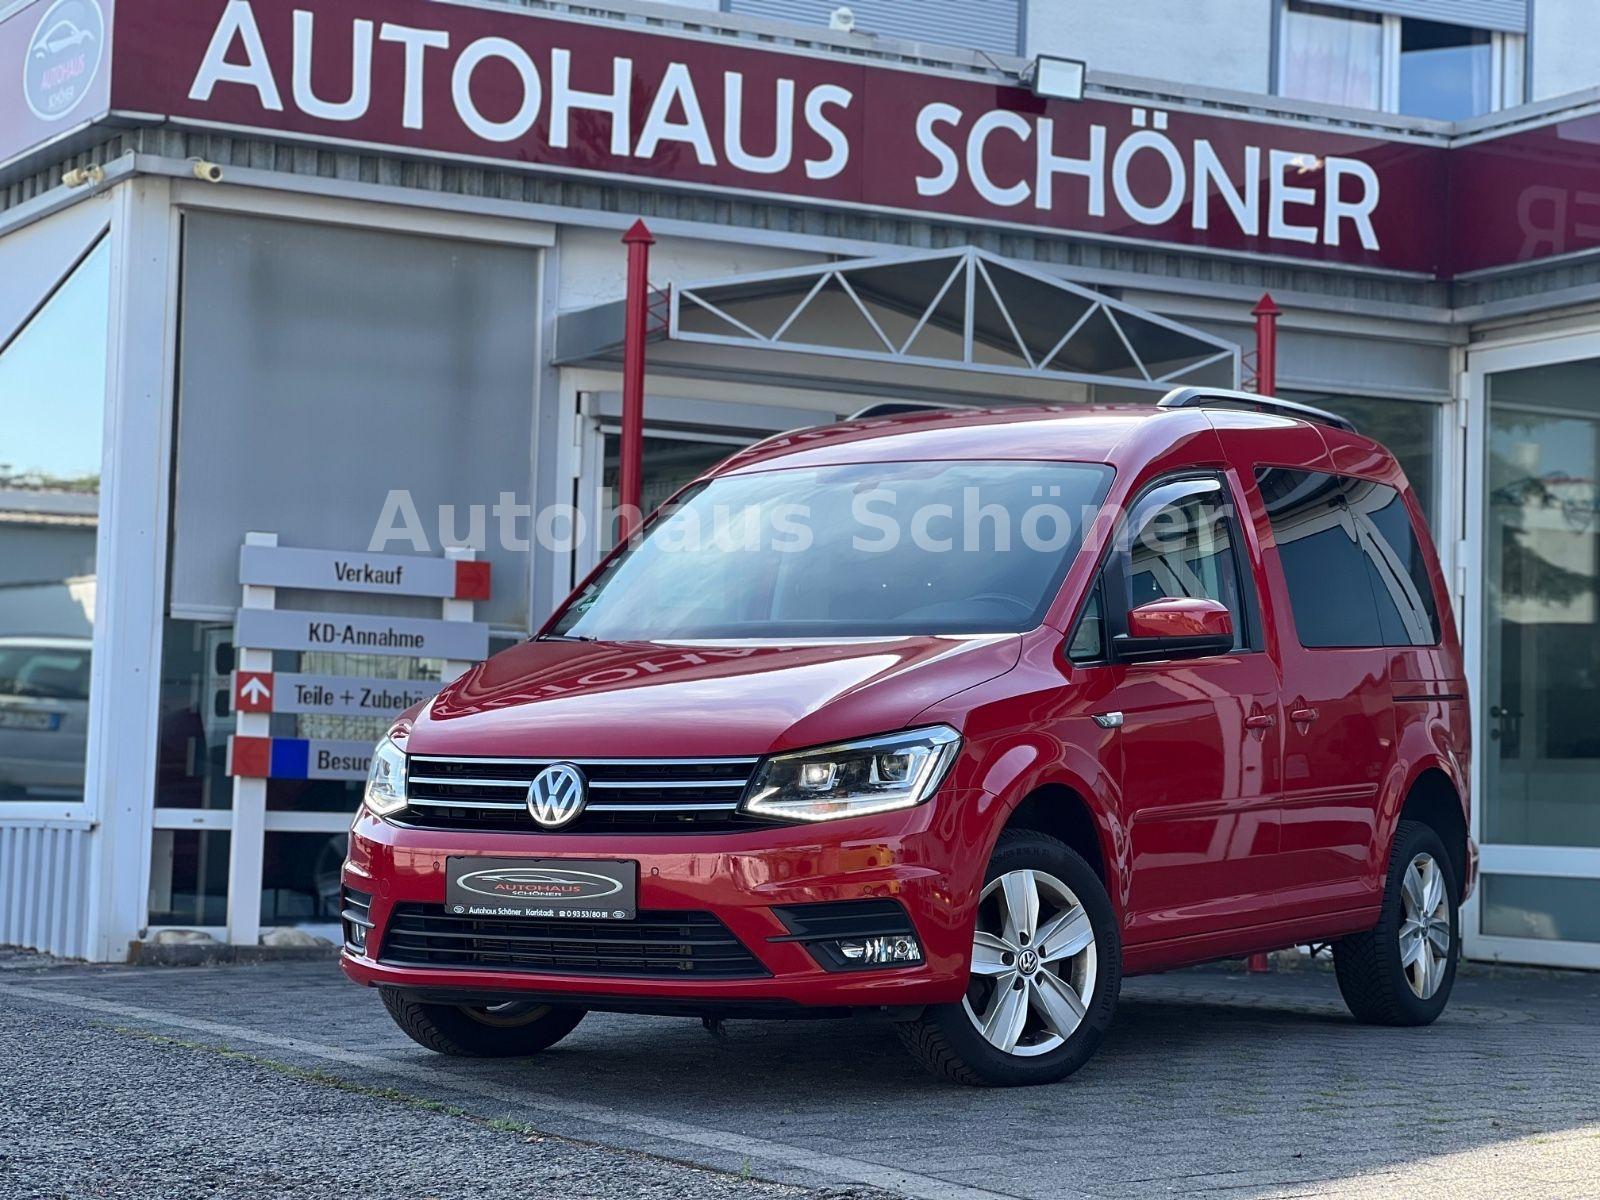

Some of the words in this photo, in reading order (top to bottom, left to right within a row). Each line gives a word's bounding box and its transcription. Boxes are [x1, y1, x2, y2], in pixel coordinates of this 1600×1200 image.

[187, 0, 853, 180] AUTOHAUS
[915, 102, 1380, 251] SCHÖNER
[334, 561, 403, 585] Verkauf
[308, 622, 424, 648] KD-Annahme
[294, 684, 333, 706] Teile
[339, 689, 354, 703] +
[494, 883, 581, 892] AUTOHAUS
[468, 906, 497, 915] Autohaus
[498, 907, 521, 916] Schöner
[525, 908, 554, 917] Karlstadt
